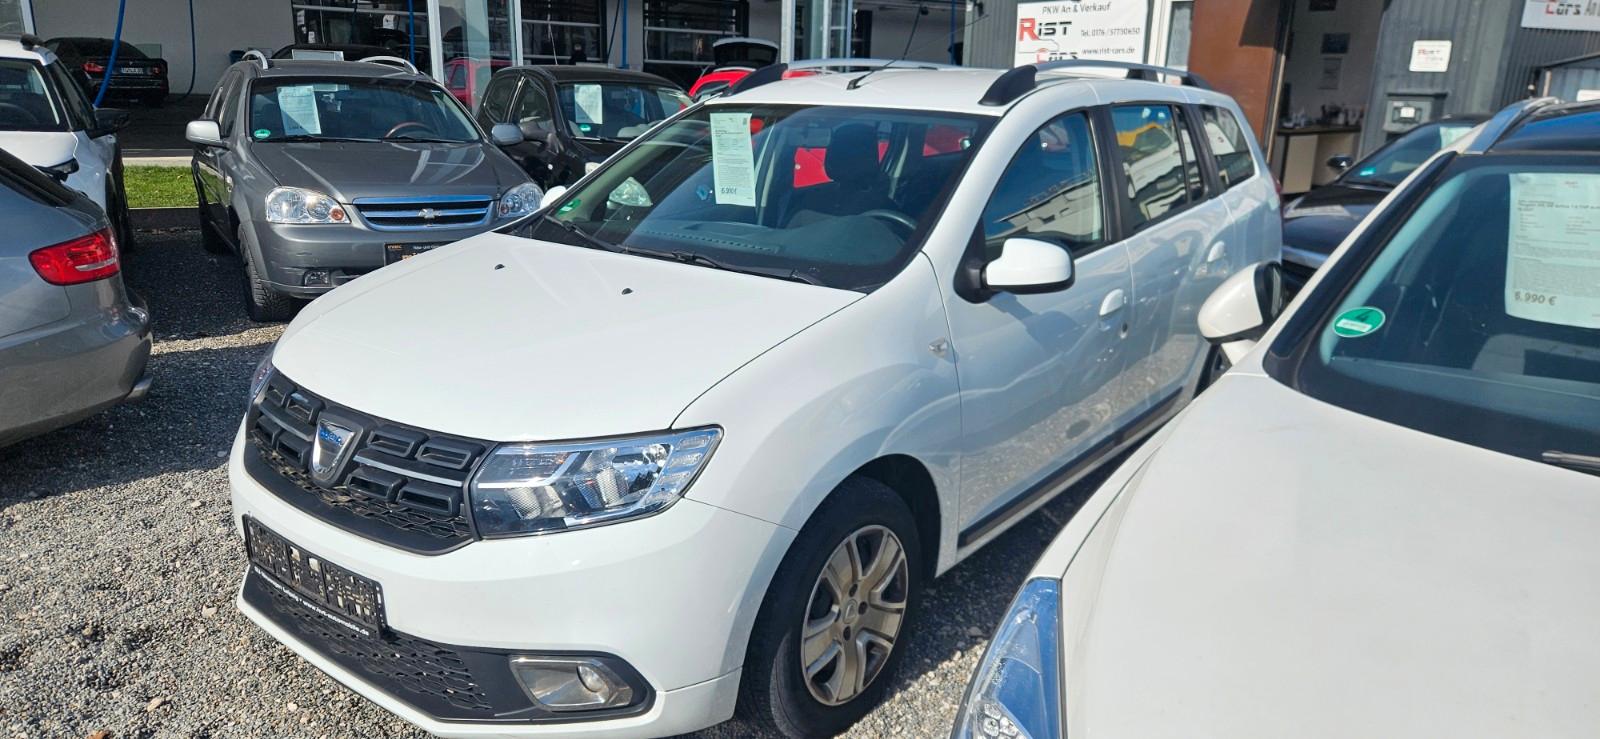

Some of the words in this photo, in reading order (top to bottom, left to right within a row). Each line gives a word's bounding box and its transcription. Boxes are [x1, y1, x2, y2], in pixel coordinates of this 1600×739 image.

[1042, 6, 1059, 14] PKW
[1073, 4, 1079, 13] &
[1080, 1, 1112, 12] Verkauf
[1548, 295, 1558, 306] €
